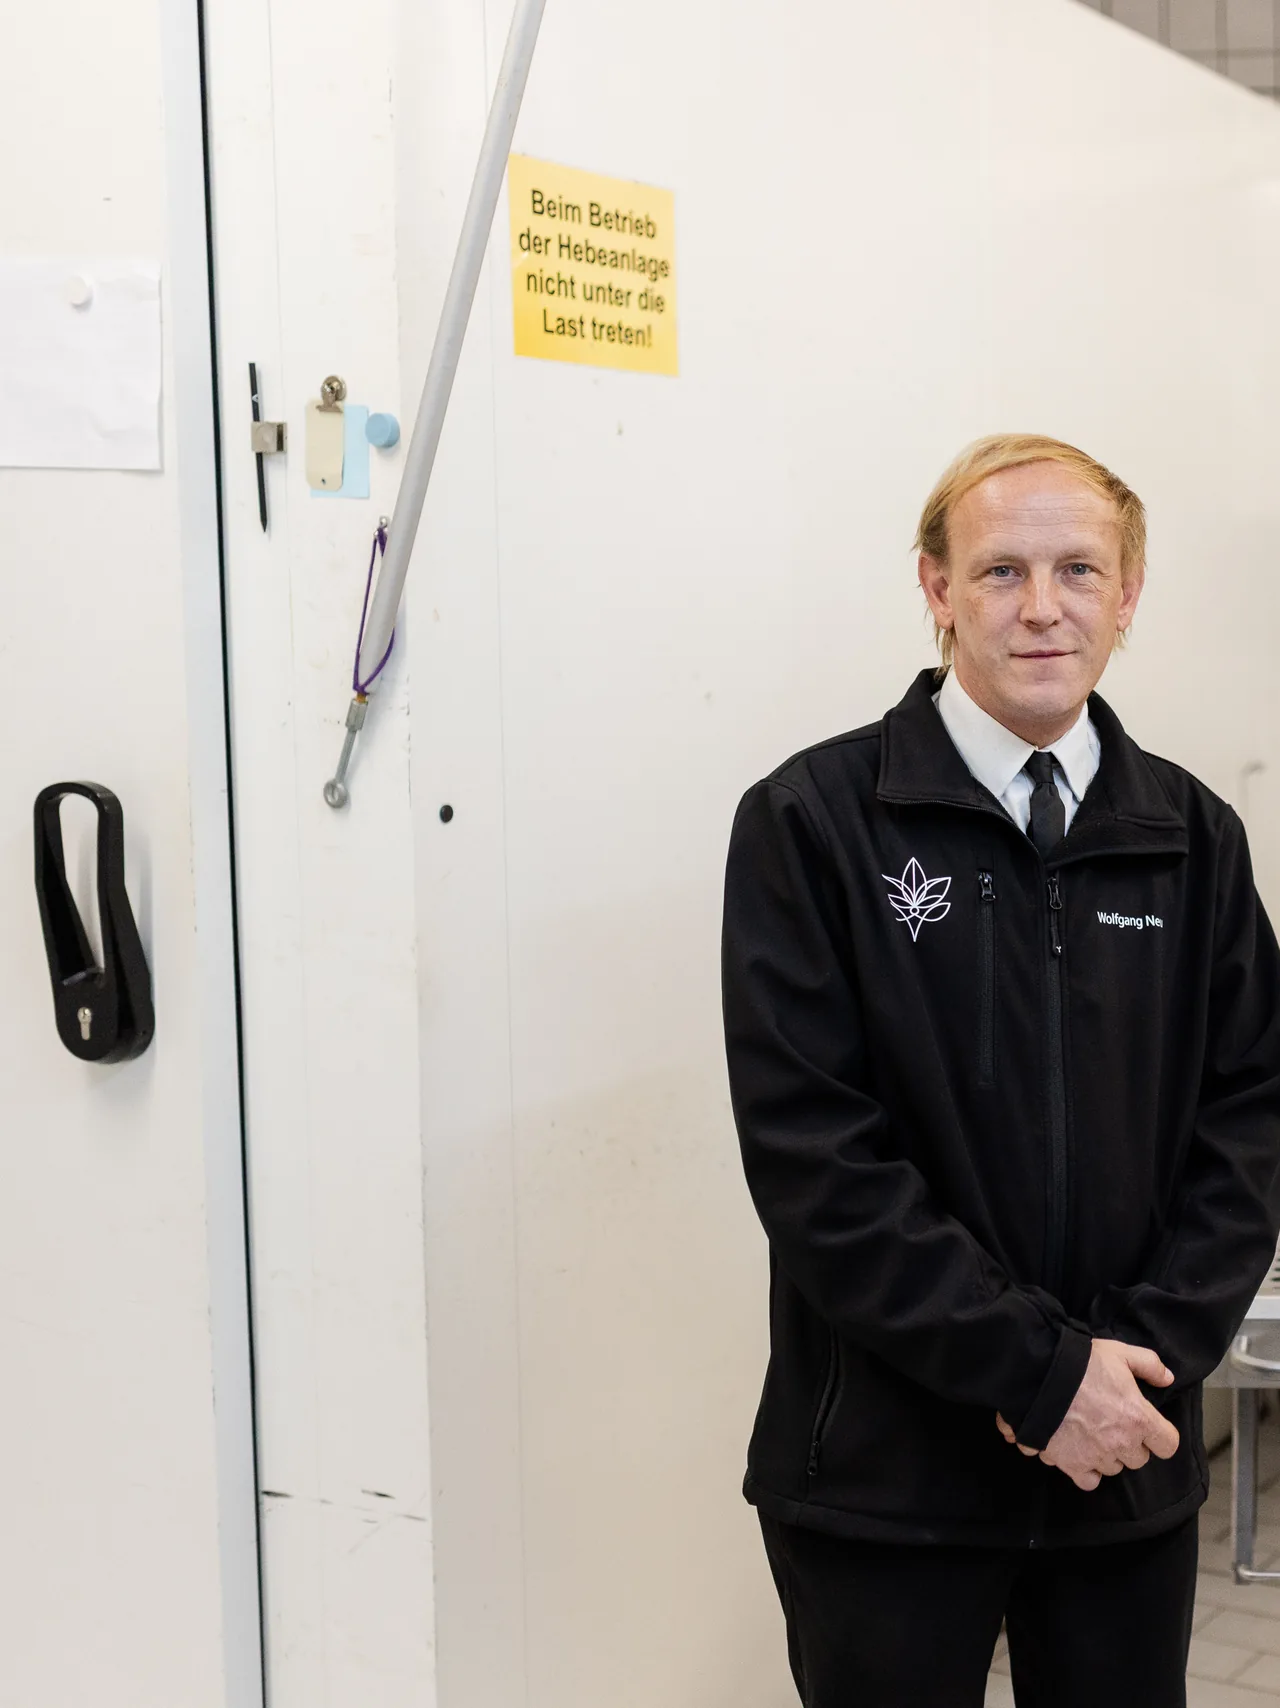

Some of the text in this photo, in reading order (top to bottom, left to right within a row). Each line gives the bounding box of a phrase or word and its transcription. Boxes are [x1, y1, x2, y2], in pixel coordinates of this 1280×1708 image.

[531, 189, 656, 239] Beim Betrieb
[518, 226, 670, 282] der Hebeanlage
[526, 269, 666, 314] nicht unter die
[543, 308, 653, 348] Last treten!
[1097, 911, 1143, 929] Wolfgang
